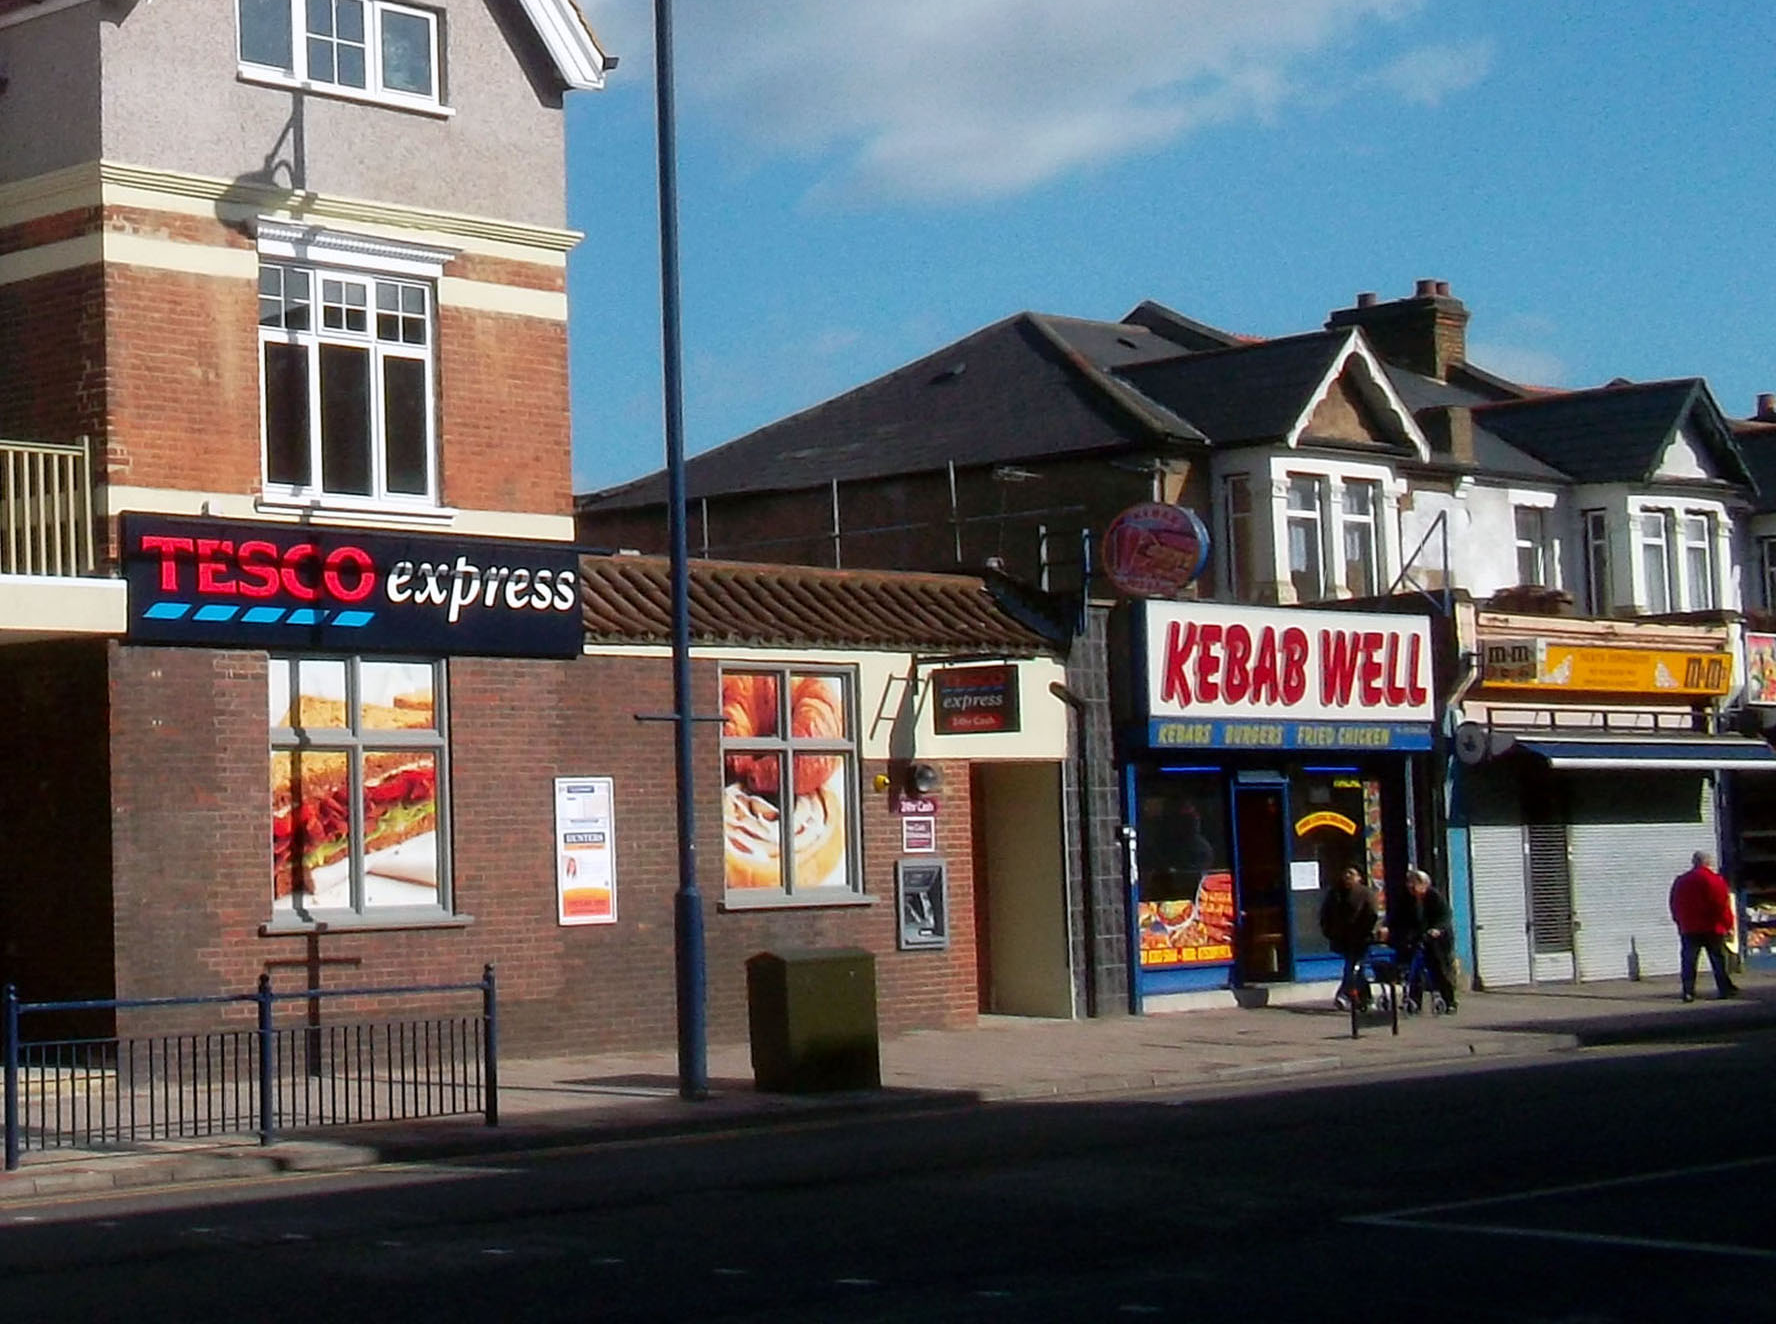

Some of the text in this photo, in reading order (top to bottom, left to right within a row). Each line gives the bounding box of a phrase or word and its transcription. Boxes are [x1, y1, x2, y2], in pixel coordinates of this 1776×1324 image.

[141, 534, 576, 623] TESCO express
[1161, 620, 1427, 709] KEBAB WELL
[942, 694, 1003, 711] express
[1158, 723, 1212, 744] KEBABS
[1225, 724, 1284, 745] BURGERS
[1296, 726, 1335, 745] FRIED
[1338, 726, 1391, 746] CHICKEN
